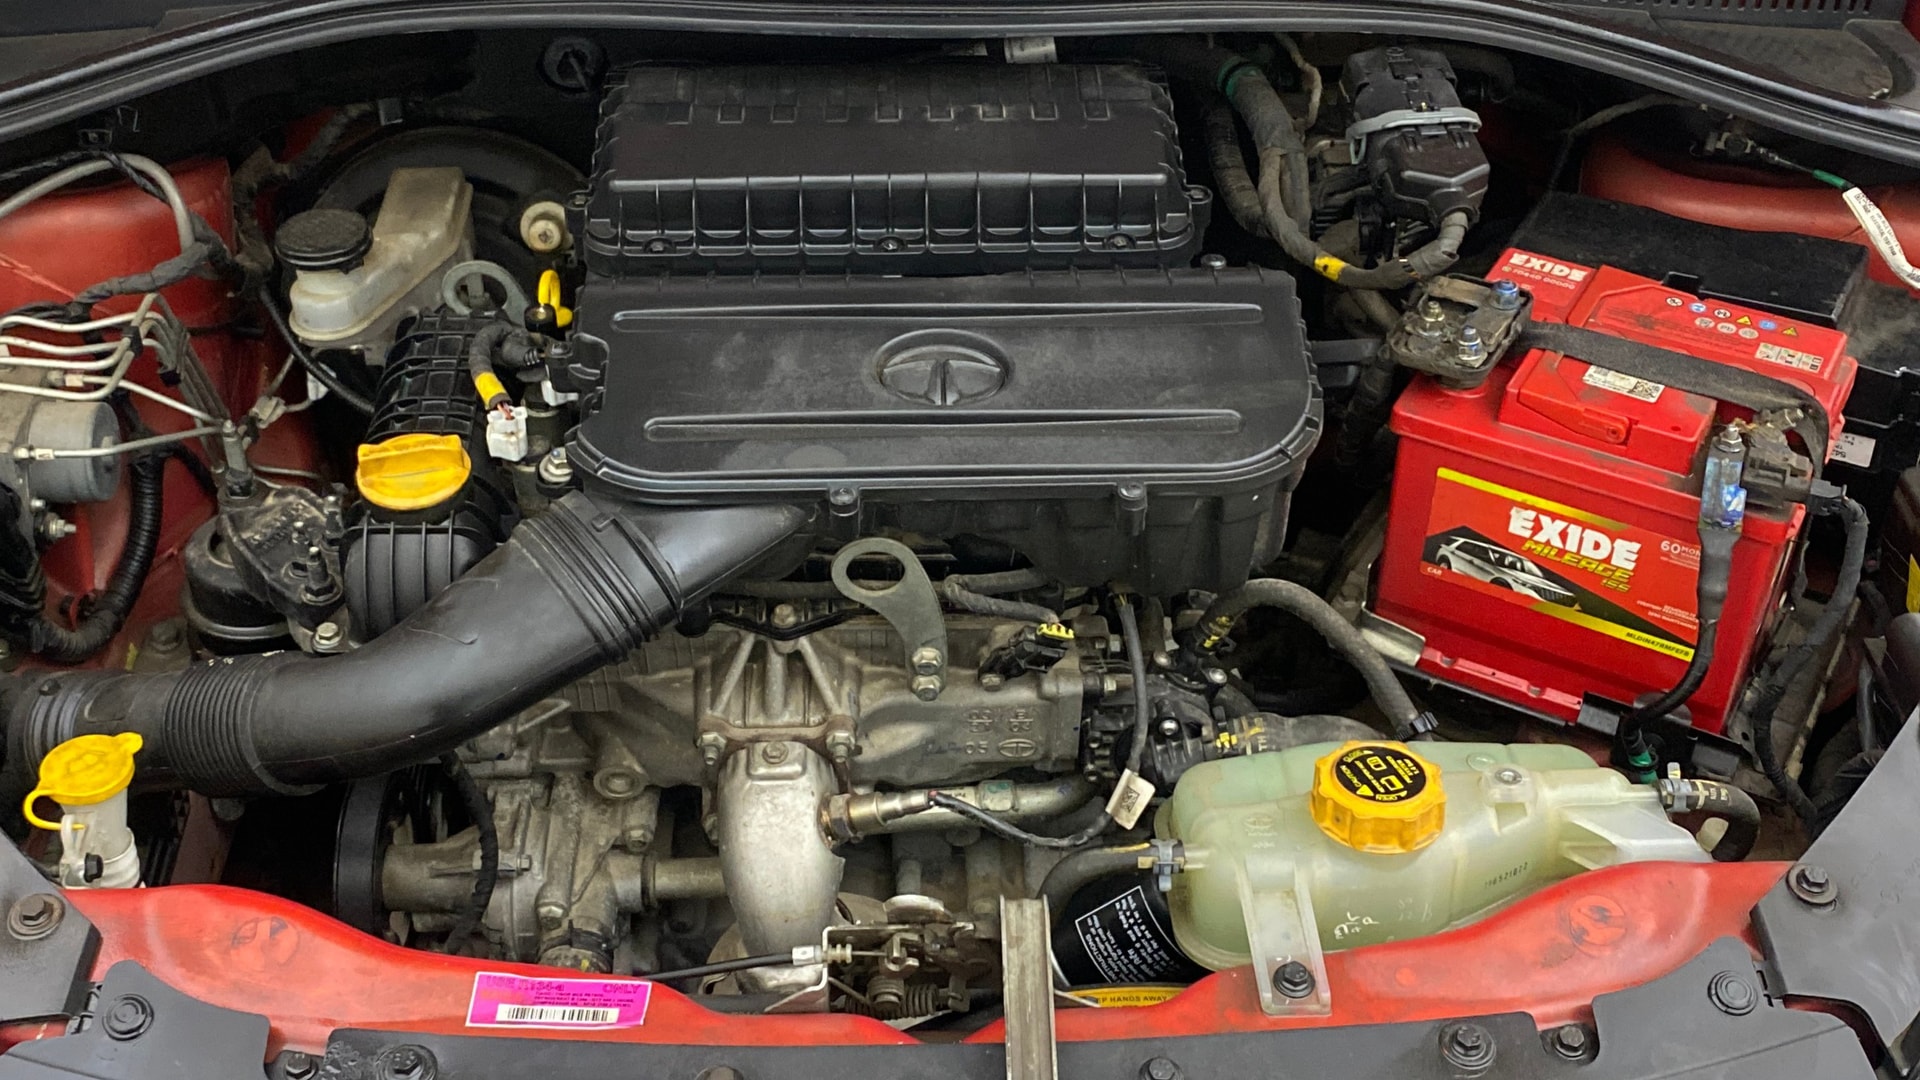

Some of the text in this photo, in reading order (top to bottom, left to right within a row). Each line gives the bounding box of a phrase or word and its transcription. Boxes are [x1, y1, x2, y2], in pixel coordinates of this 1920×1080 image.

[1509, 253, 1588, 282] EXIDE
[1508, 506, 1642, 571] EXIDE
[1660, 540, 1681, 554] 60
[1427, 566, 1442, 576] CAR
[1521, 540, 1634, 583] MILEAGE
[1085, 934, 1117, 980] INSTRUCTIONS
[602, 983, 642, 994] ONLY
